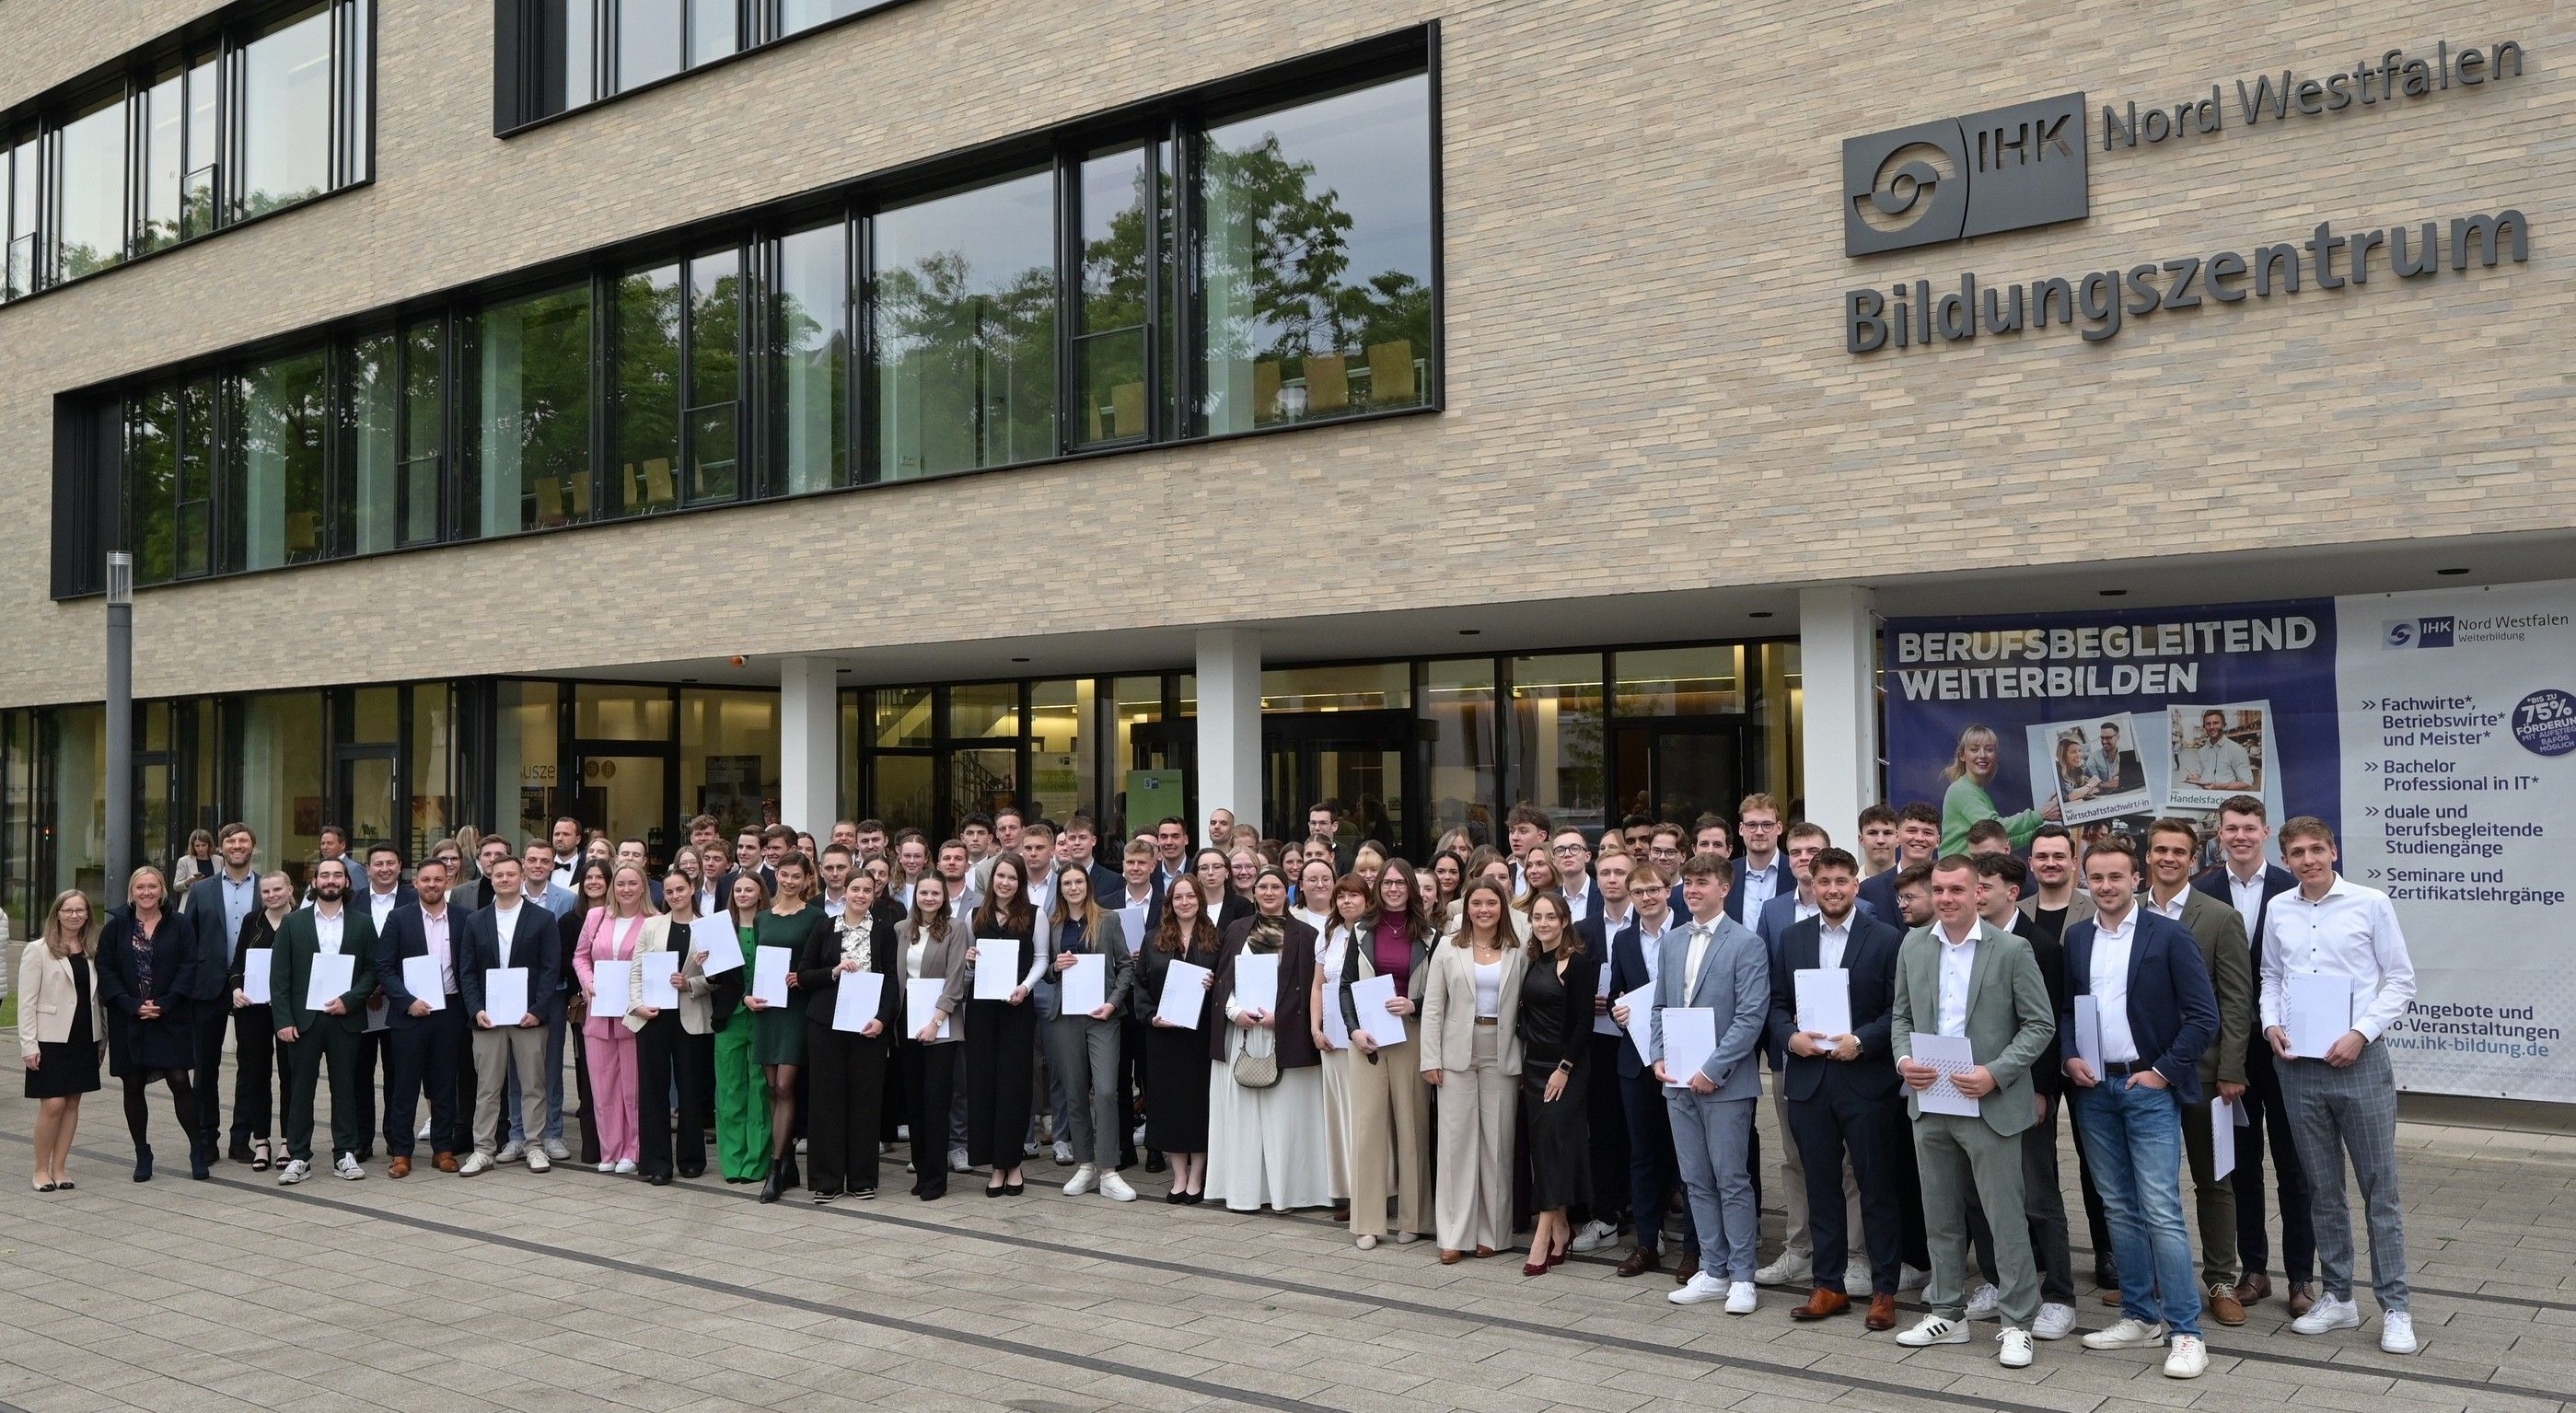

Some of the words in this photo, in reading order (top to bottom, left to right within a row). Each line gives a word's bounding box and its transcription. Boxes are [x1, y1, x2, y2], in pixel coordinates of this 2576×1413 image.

[2102, 84, 2222, 151] Nord
[2236, 40, 2524, 125] Westfalen
[1977, 113, 2075, 173] IHK
[1845, 208, 2529, 354] Bildungszentrum
[2422, 620, 2452, 634] IHK
[2458, 618, 2491, 631] Nord
[2495, 614, 2569, 628] Westfalen
[1897, 616, 2316, 664] BERUFSBEGLEITEND
[2458, 632, 2525, 643] Weiterbildung
[1898, 662, 2199, 701] WEITERBILDEN
[2521, 698, 2572, 724] 75%
[2384, 732, 2414, 747] und
[2522, 734, 2536, 742] MIT
[521, 764, 556, 779] usze
[2384, 759, 2456, 773] Bachelor
[2385, 776, 2488, 791] Professional
[2493, 777, 2509, 790] in
[2170, 793, 2229, 805] Handelsfach
[2385, 805, 2431, 819] duale
[2435, 805, 2468, 819] und
[2385, 822, 2544, 840] berufsbegleitende
[2386, 840, 2503, 858] Studiengänge
[2386, 868, 2466, 883] Seminare
[2471, 868, 2503, 883] und
[2388, 886, 2565, 906] Zertifikatslehrgänge
[2408, 1001, 2493, 1019] Angebote
[2500, 1005, 2533, 1020] und
[2388, 1018, 2559, 1041] o-Veranstaltungen
[2385, 1036, 2549, 1059] ww.ihk-bildung.de
